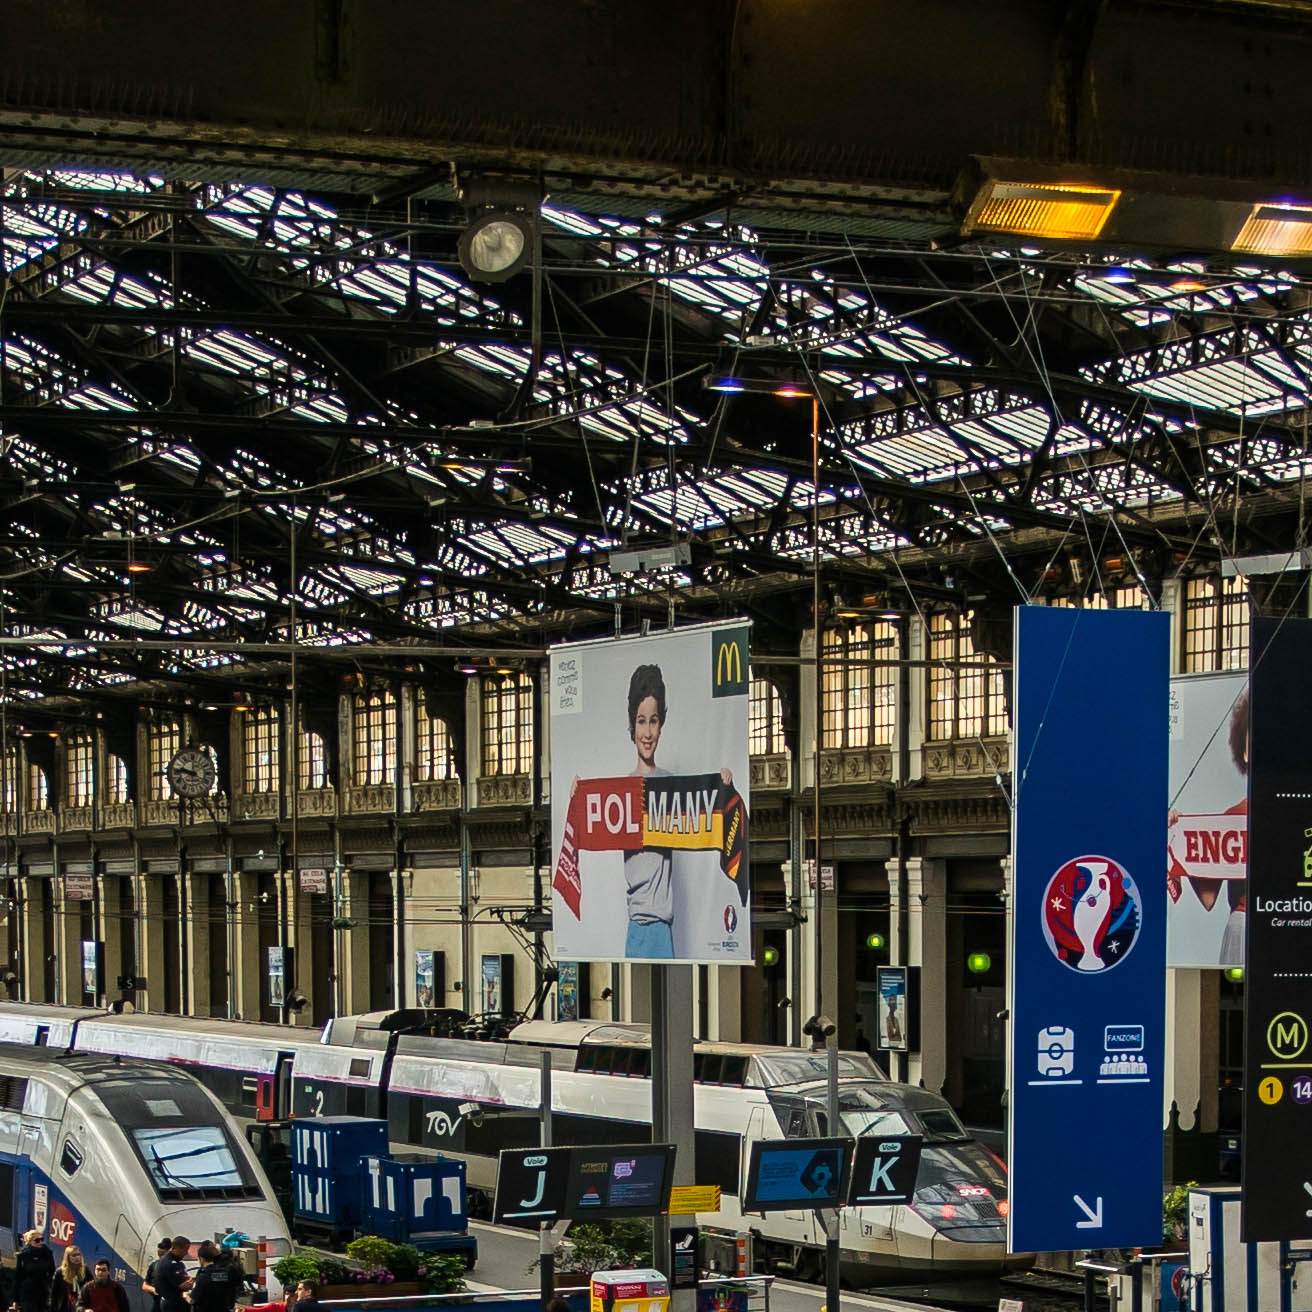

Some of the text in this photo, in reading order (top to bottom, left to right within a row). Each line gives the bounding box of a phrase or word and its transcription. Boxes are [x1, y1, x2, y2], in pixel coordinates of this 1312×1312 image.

[586, 789, 719, 835] POL MANY
[1271, 917, 1286, 928] Car
[1287, 917, 1312, 928] rental
[1107, 1034, 1141, 1042] FANZONE
[1265, 1083, 1274, 1098] 1
[1292, 1082, 1312, 1099] 14
[426, 1111, 462, 1137] TGV
[869, 1156, 901, 1192] K
[519, 1170, 546, 1208] J
[50, 1218, 76, 1241] SNCF
[864, 1225, 873, 1236] 31
